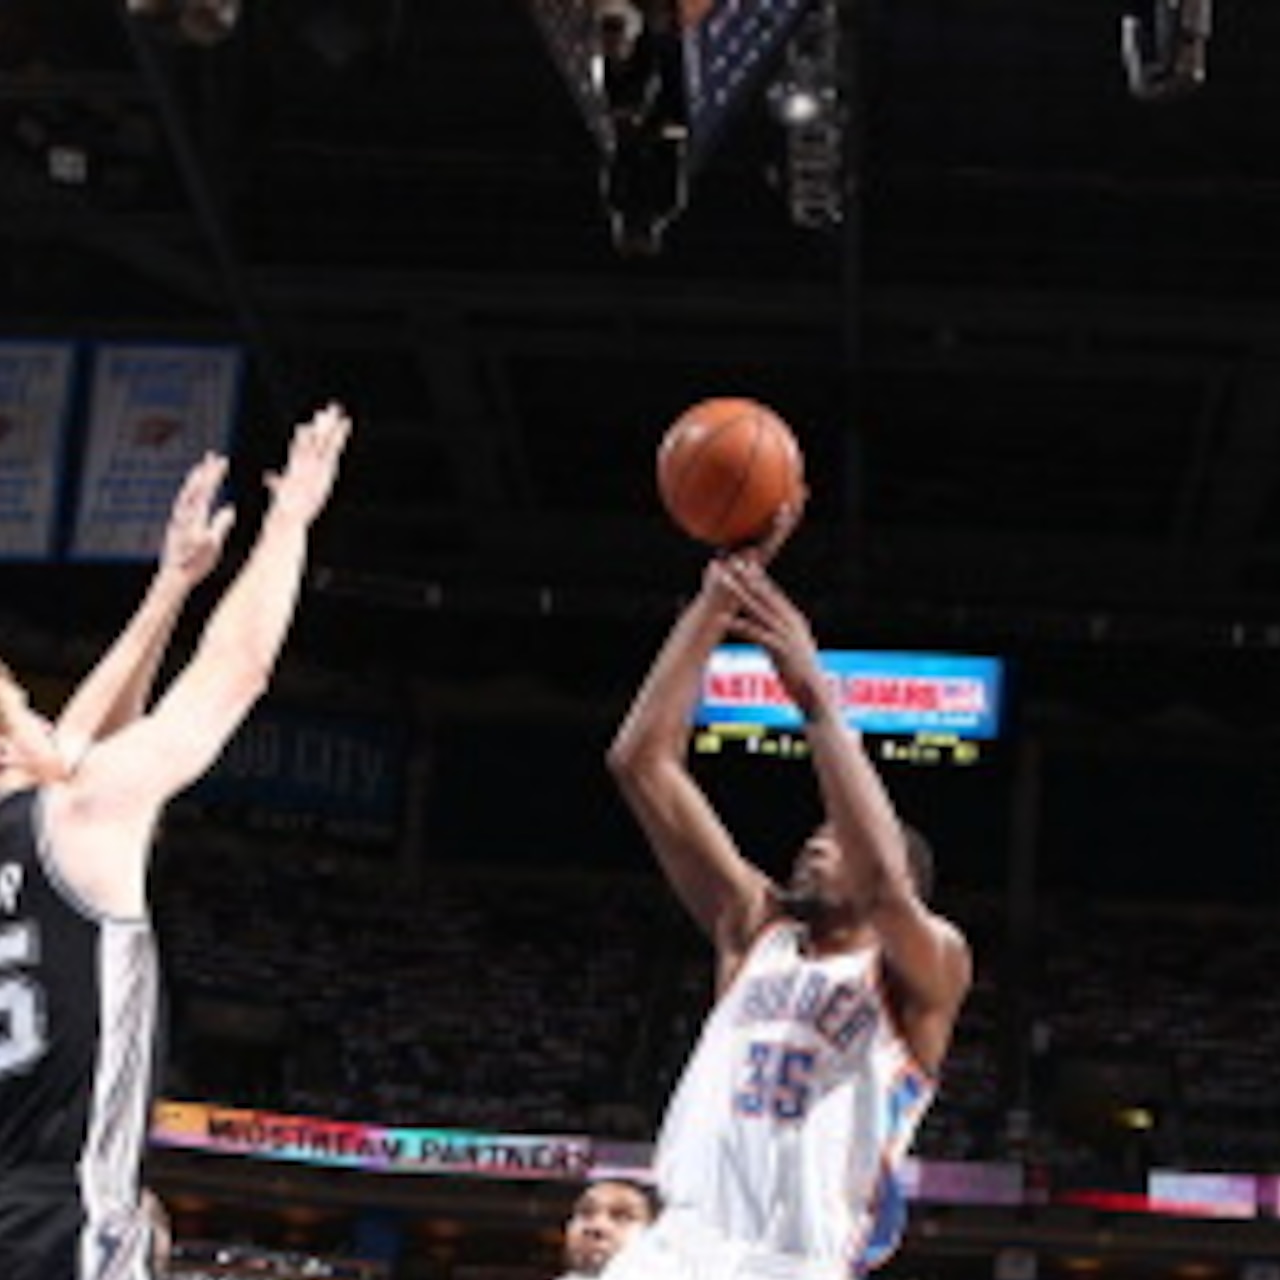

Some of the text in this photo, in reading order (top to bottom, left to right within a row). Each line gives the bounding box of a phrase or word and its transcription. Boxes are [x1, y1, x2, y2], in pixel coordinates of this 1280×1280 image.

[735, 1041, 817, 1122] 35
[208, 1114, 595, 1171] MIDSTREAM PARTNERS
